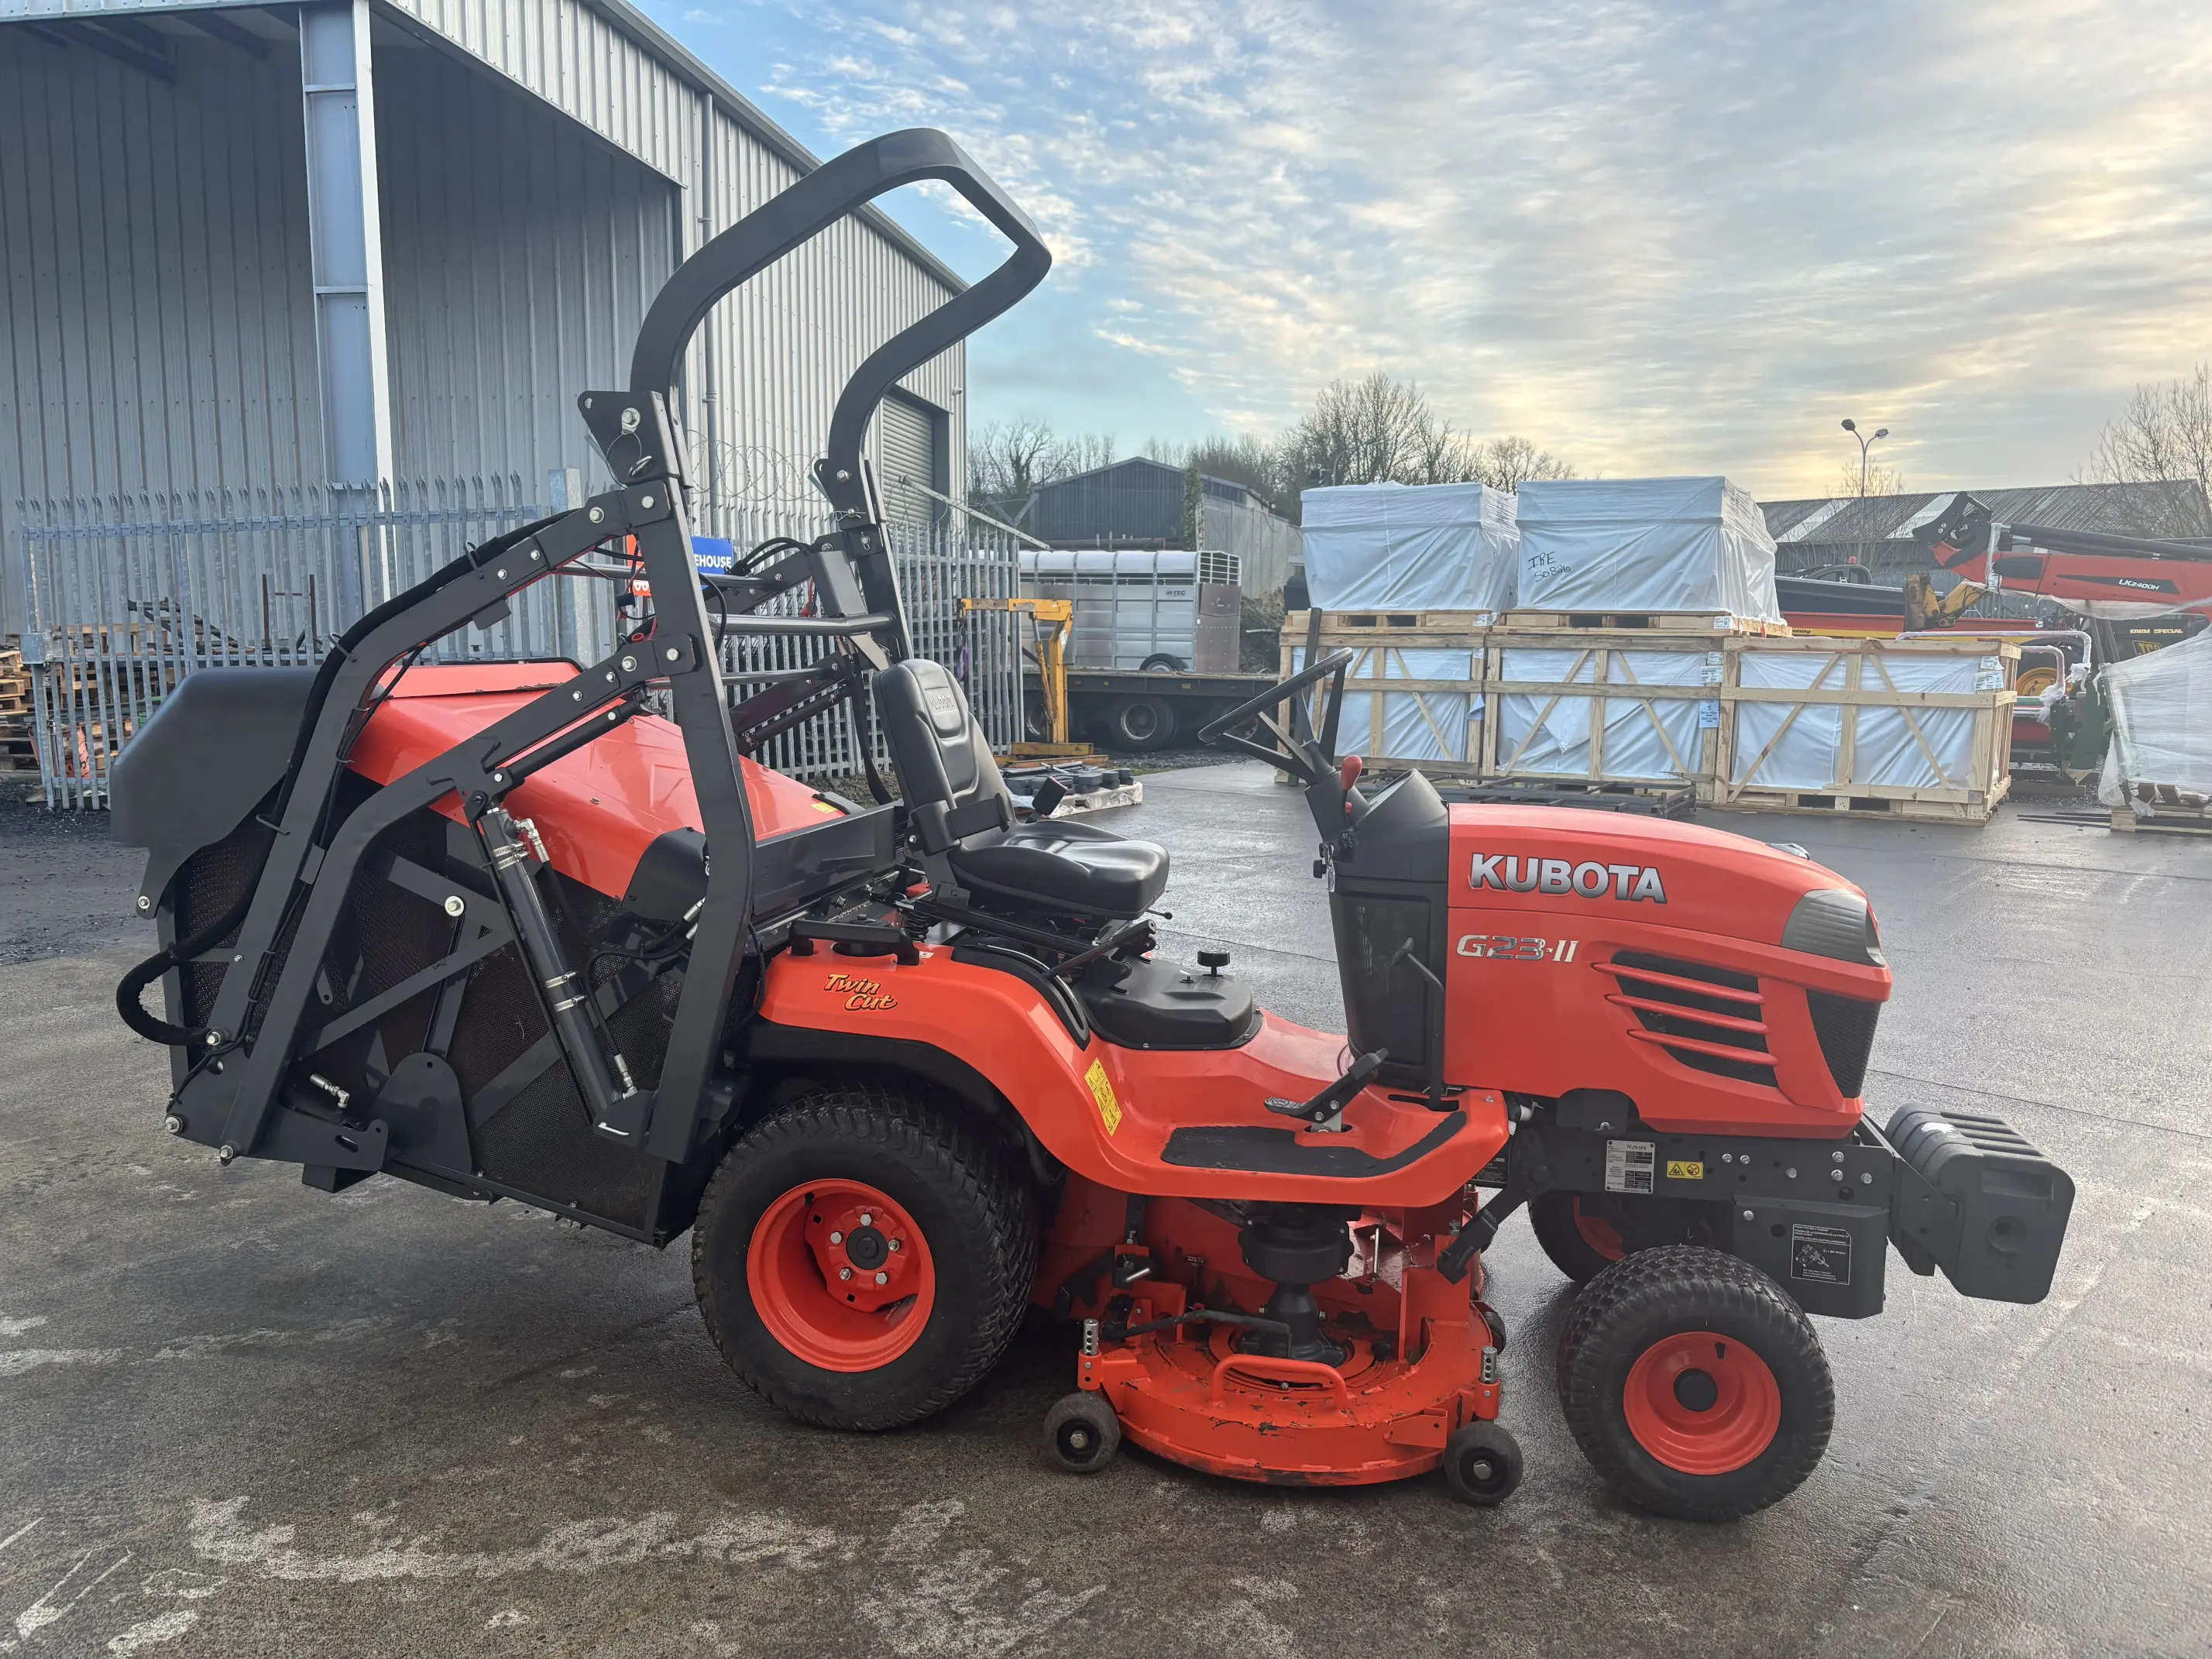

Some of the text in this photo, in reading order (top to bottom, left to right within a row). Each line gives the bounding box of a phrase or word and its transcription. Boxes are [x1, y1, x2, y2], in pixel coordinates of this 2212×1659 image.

[1527, 551, 1557, 571] IRE
[2118, 579, 2160, 590] LK2400H
[1469, 852, 1668, 905] KUBOTA
[823, 973, 881, 995] Twin
[844, 993, 898, 1012] Cut
